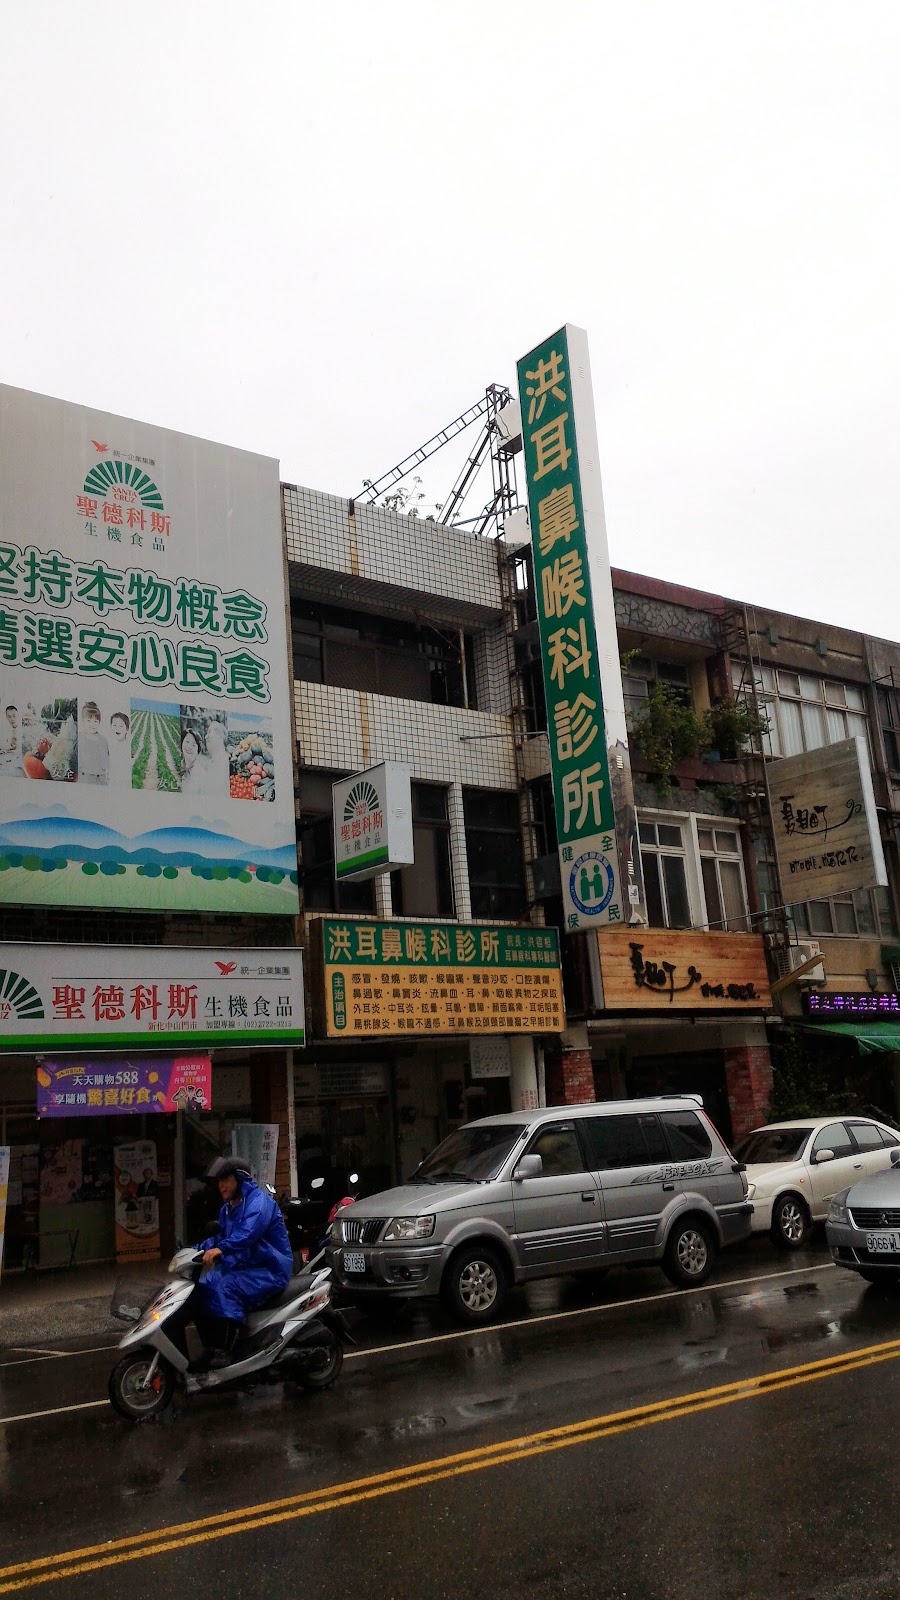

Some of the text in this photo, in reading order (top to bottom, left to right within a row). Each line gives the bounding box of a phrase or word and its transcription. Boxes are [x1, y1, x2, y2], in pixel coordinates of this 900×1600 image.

[112, 486, 138, 498] SANTA
[114, 493, 136, 503] CRUZ
[77, 495, 171, 536] 聖德科斯
[84, 521, 165, 551] 生機食品
[525, 350, 604, 834] 洪耳鼻喉科診所
[341, 810, 383, 842] 聖德科斯
[328, 926, 500, 963] 洪耳鼻喉科診所
[240, 966, 291, 976] 統一企業集團
[52, 984, 199, 1021] 聖德科斯
[204, 995, 293, 1018] 生機食品
[147, 1021, 198, 1031] 新化中山門市
